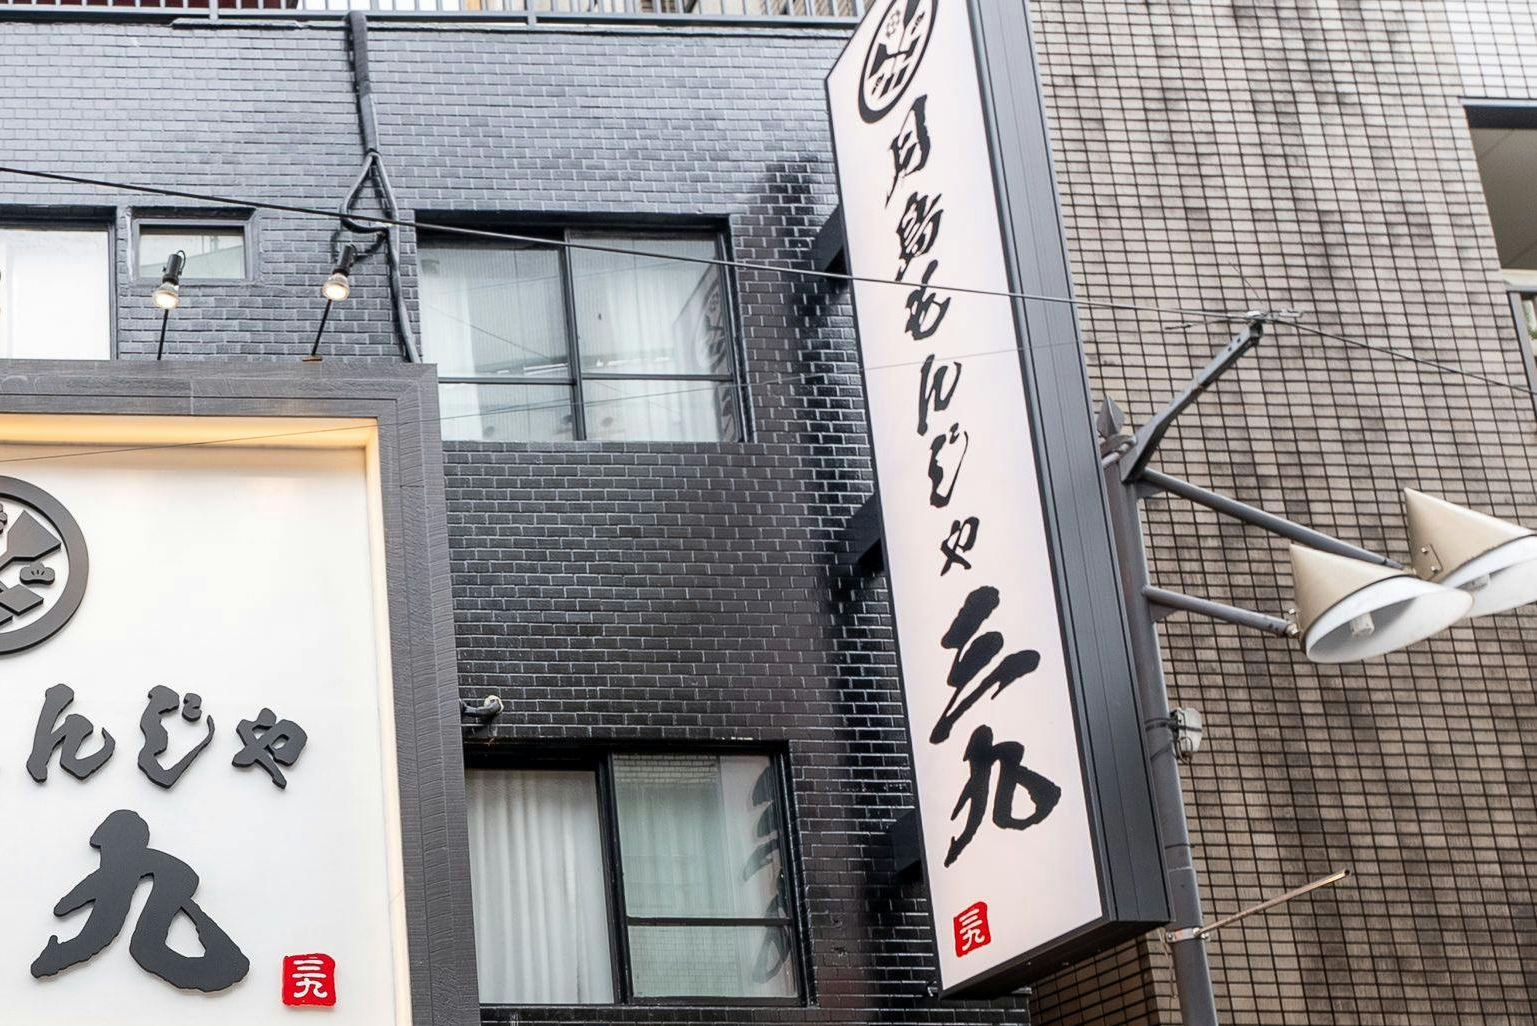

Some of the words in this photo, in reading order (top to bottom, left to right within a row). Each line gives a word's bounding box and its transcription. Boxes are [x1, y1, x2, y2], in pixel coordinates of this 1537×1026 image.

[929, 586, 1061, 869] 三九
[958, 904, 989, 955] 三九
[289, 956, 329, 1000] 三九
